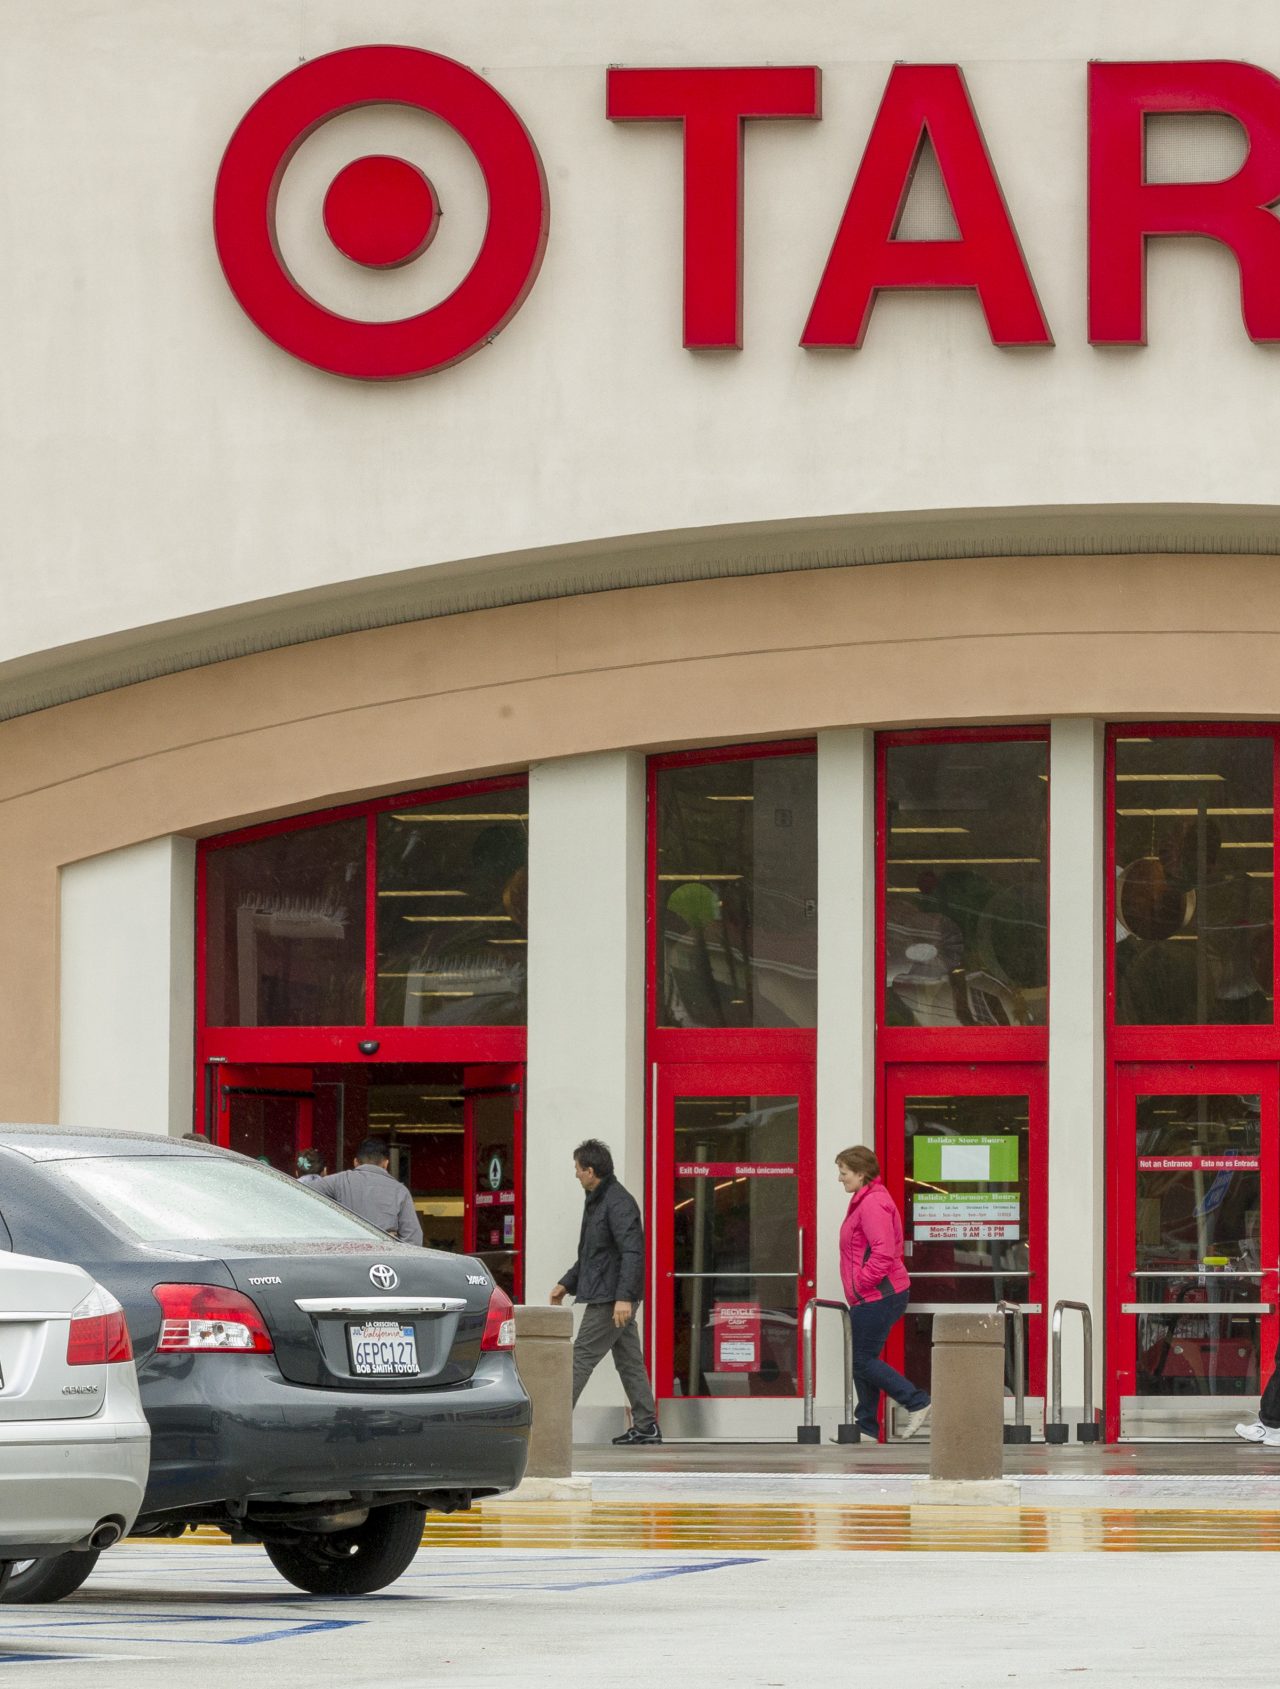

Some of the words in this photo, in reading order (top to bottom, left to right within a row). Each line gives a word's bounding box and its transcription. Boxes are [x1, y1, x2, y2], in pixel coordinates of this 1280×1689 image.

[1140, 1160, 1151, 1168] Not
[1163, 1160, 1192, 1168] Entrance
[679, 1166, 692, 1174] Exit
[694, 1166, 709, 1175] Only
[735, 1166, 755, 1174] Salida
[756, 1165, 794, 1174] únicamente
[248, 1276, 282, 1285] TOYOTA
[720, 1308, 755, 1316] RECYCLE
[363, 1327, 400, 1341] California
[356, 1342, 413, 1365] 6EPC127
[356, 1364, 371, 1373] BOB
[372, 1364, 393, 1373] SMITH
[394, 1364, 420, 1373] TOYOTA
